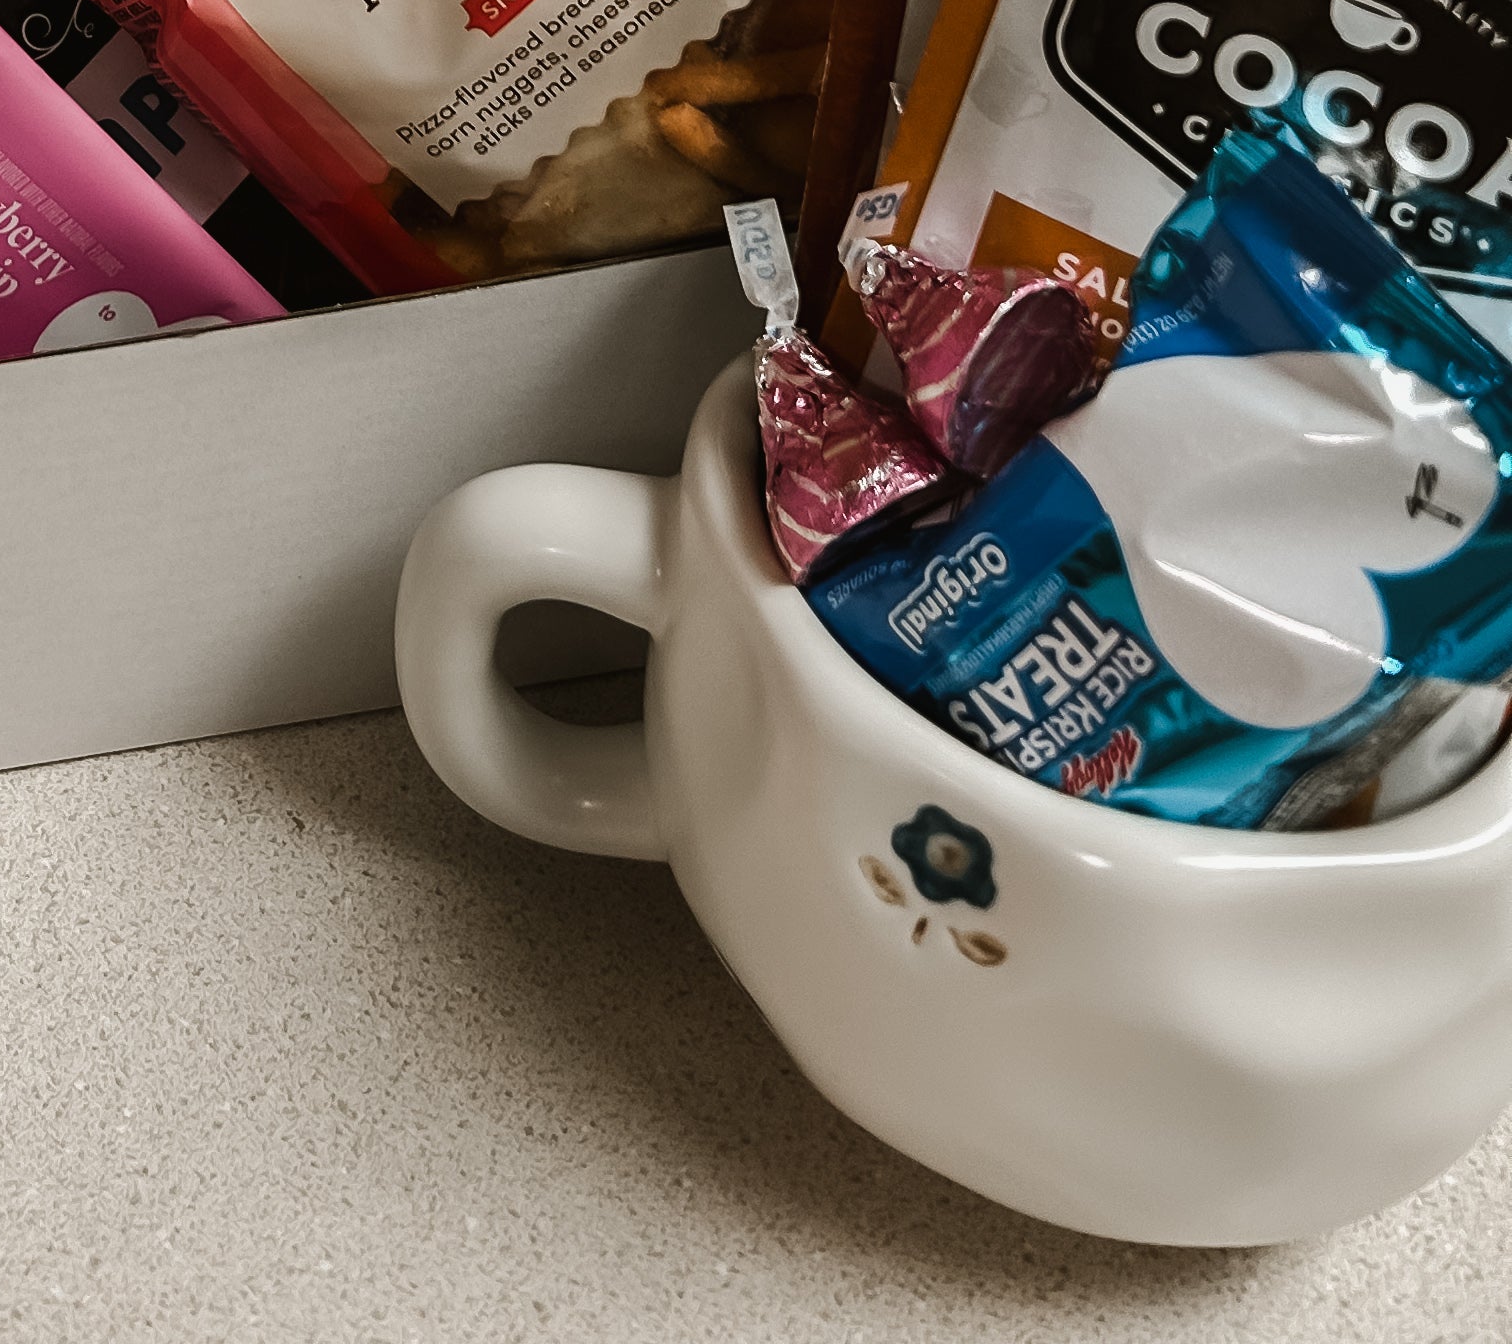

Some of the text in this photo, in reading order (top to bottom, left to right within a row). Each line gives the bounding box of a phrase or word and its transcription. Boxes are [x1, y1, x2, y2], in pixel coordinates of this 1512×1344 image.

[395, 30, 544, 145] Pizza-flavored
[426, 119, 476, 158] corn
[475, 50, 568, 123] nuggets,
[472, 104, 533, 156] sticks
[534, 69, 577, 108] and
[98, 304, 116, 321] to
[900, 542, 1008, 646] Original
[949, 600, 1120, 750] TREATS
[1087, 638, 1155, 710] RICE
